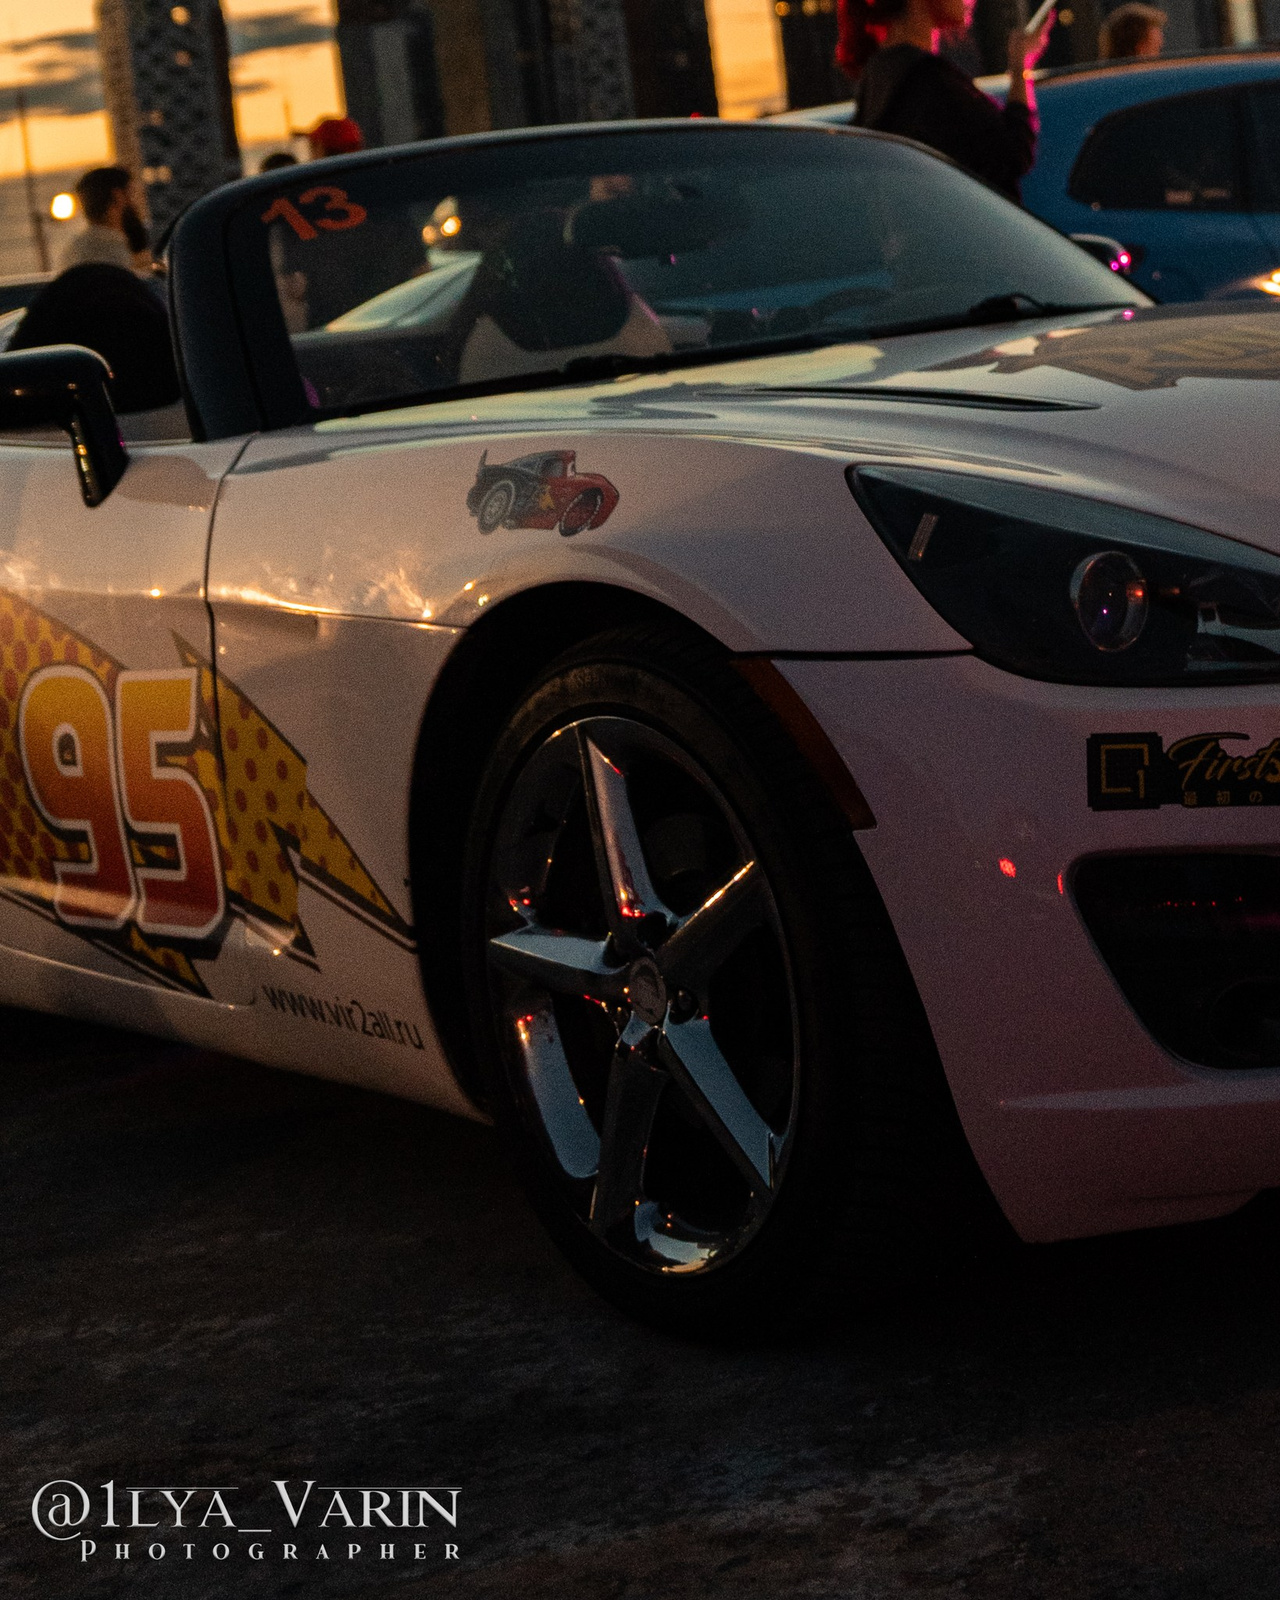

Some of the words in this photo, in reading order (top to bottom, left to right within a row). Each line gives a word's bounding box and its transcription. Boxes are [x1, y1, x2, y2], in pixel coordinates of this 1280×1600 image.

[260, 185, 368, 241] 13
[18, 664, 227, 941] 95
[262, 985, 425, 1050] www.vir2all.ru
